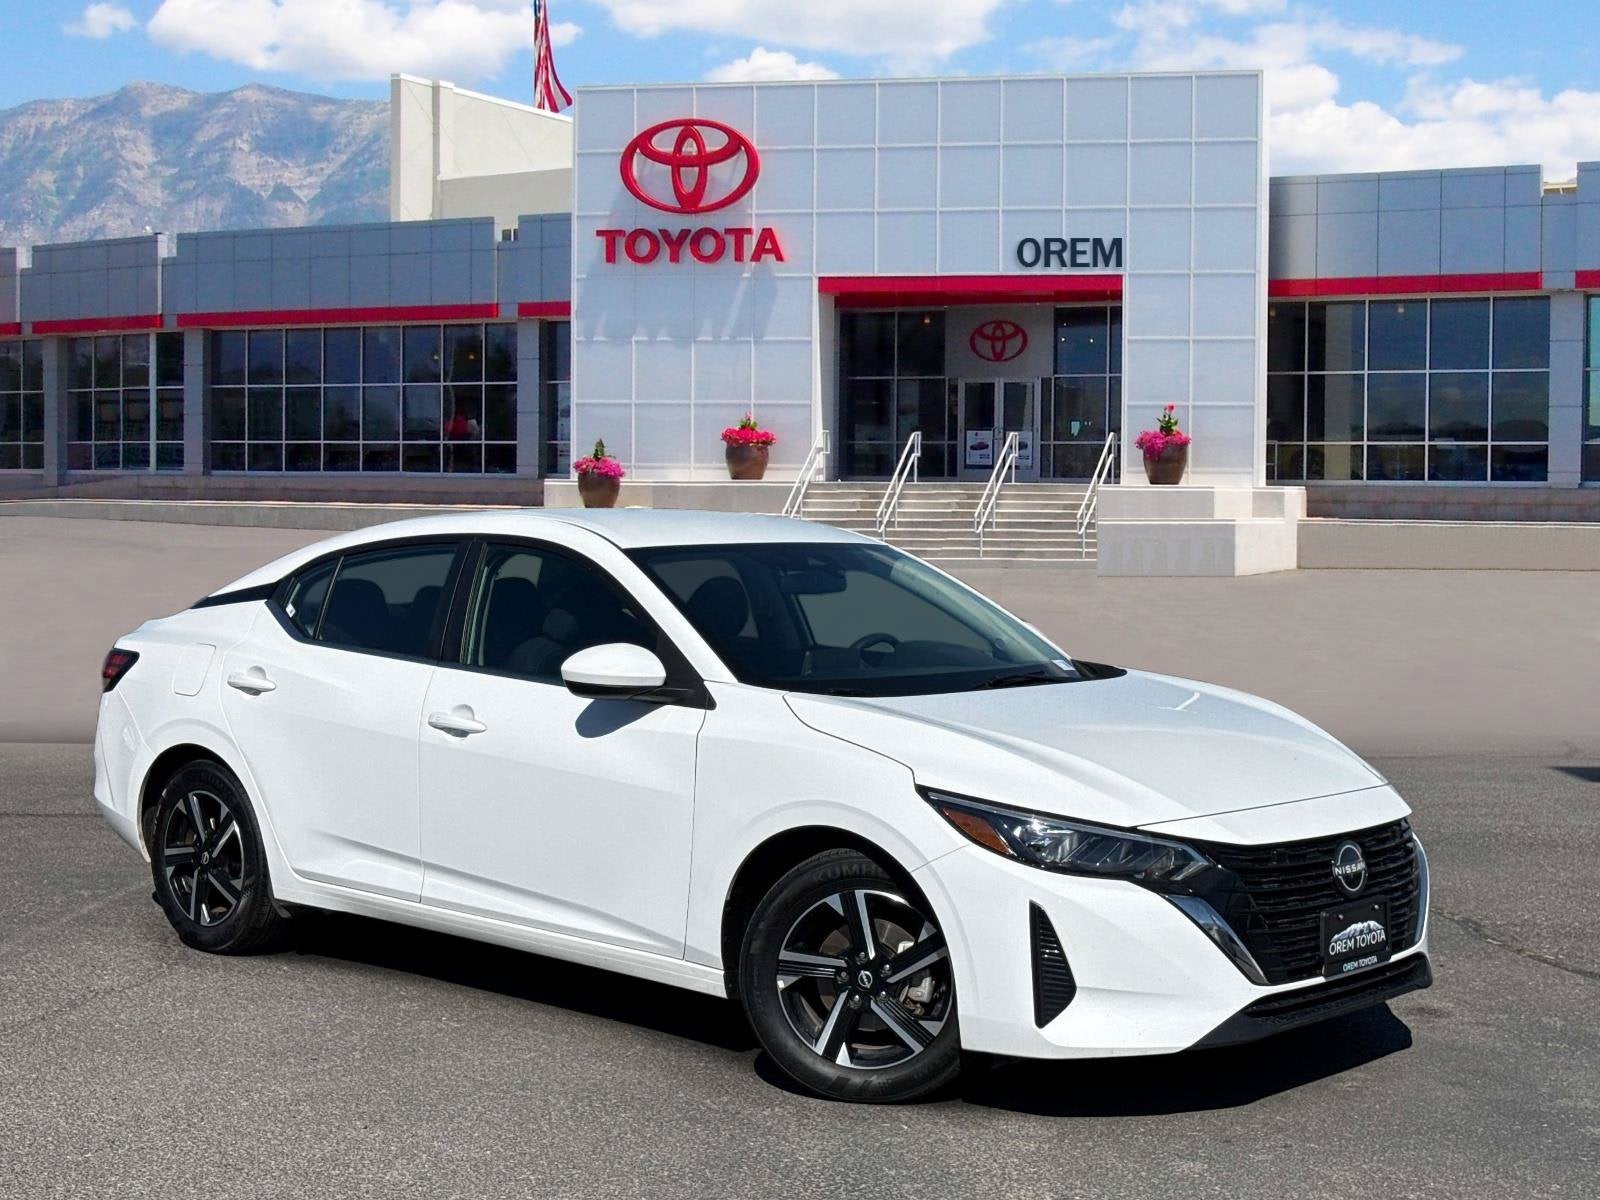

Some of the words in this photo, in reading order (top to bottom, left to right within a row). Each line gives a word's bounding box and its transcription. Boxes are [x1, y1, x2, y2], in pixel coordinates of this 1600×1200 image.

[596, 227, 784, 264] TOYOTA
[1017, 237, 1123, 268] OREM
[1329, 938, 1355, 955] OREM
[1356, 929, 1386, 949] TOYOTA
[1343, 961, 1358, 972] OREM
[1359, 955, 1378, 968] TOYOTA
